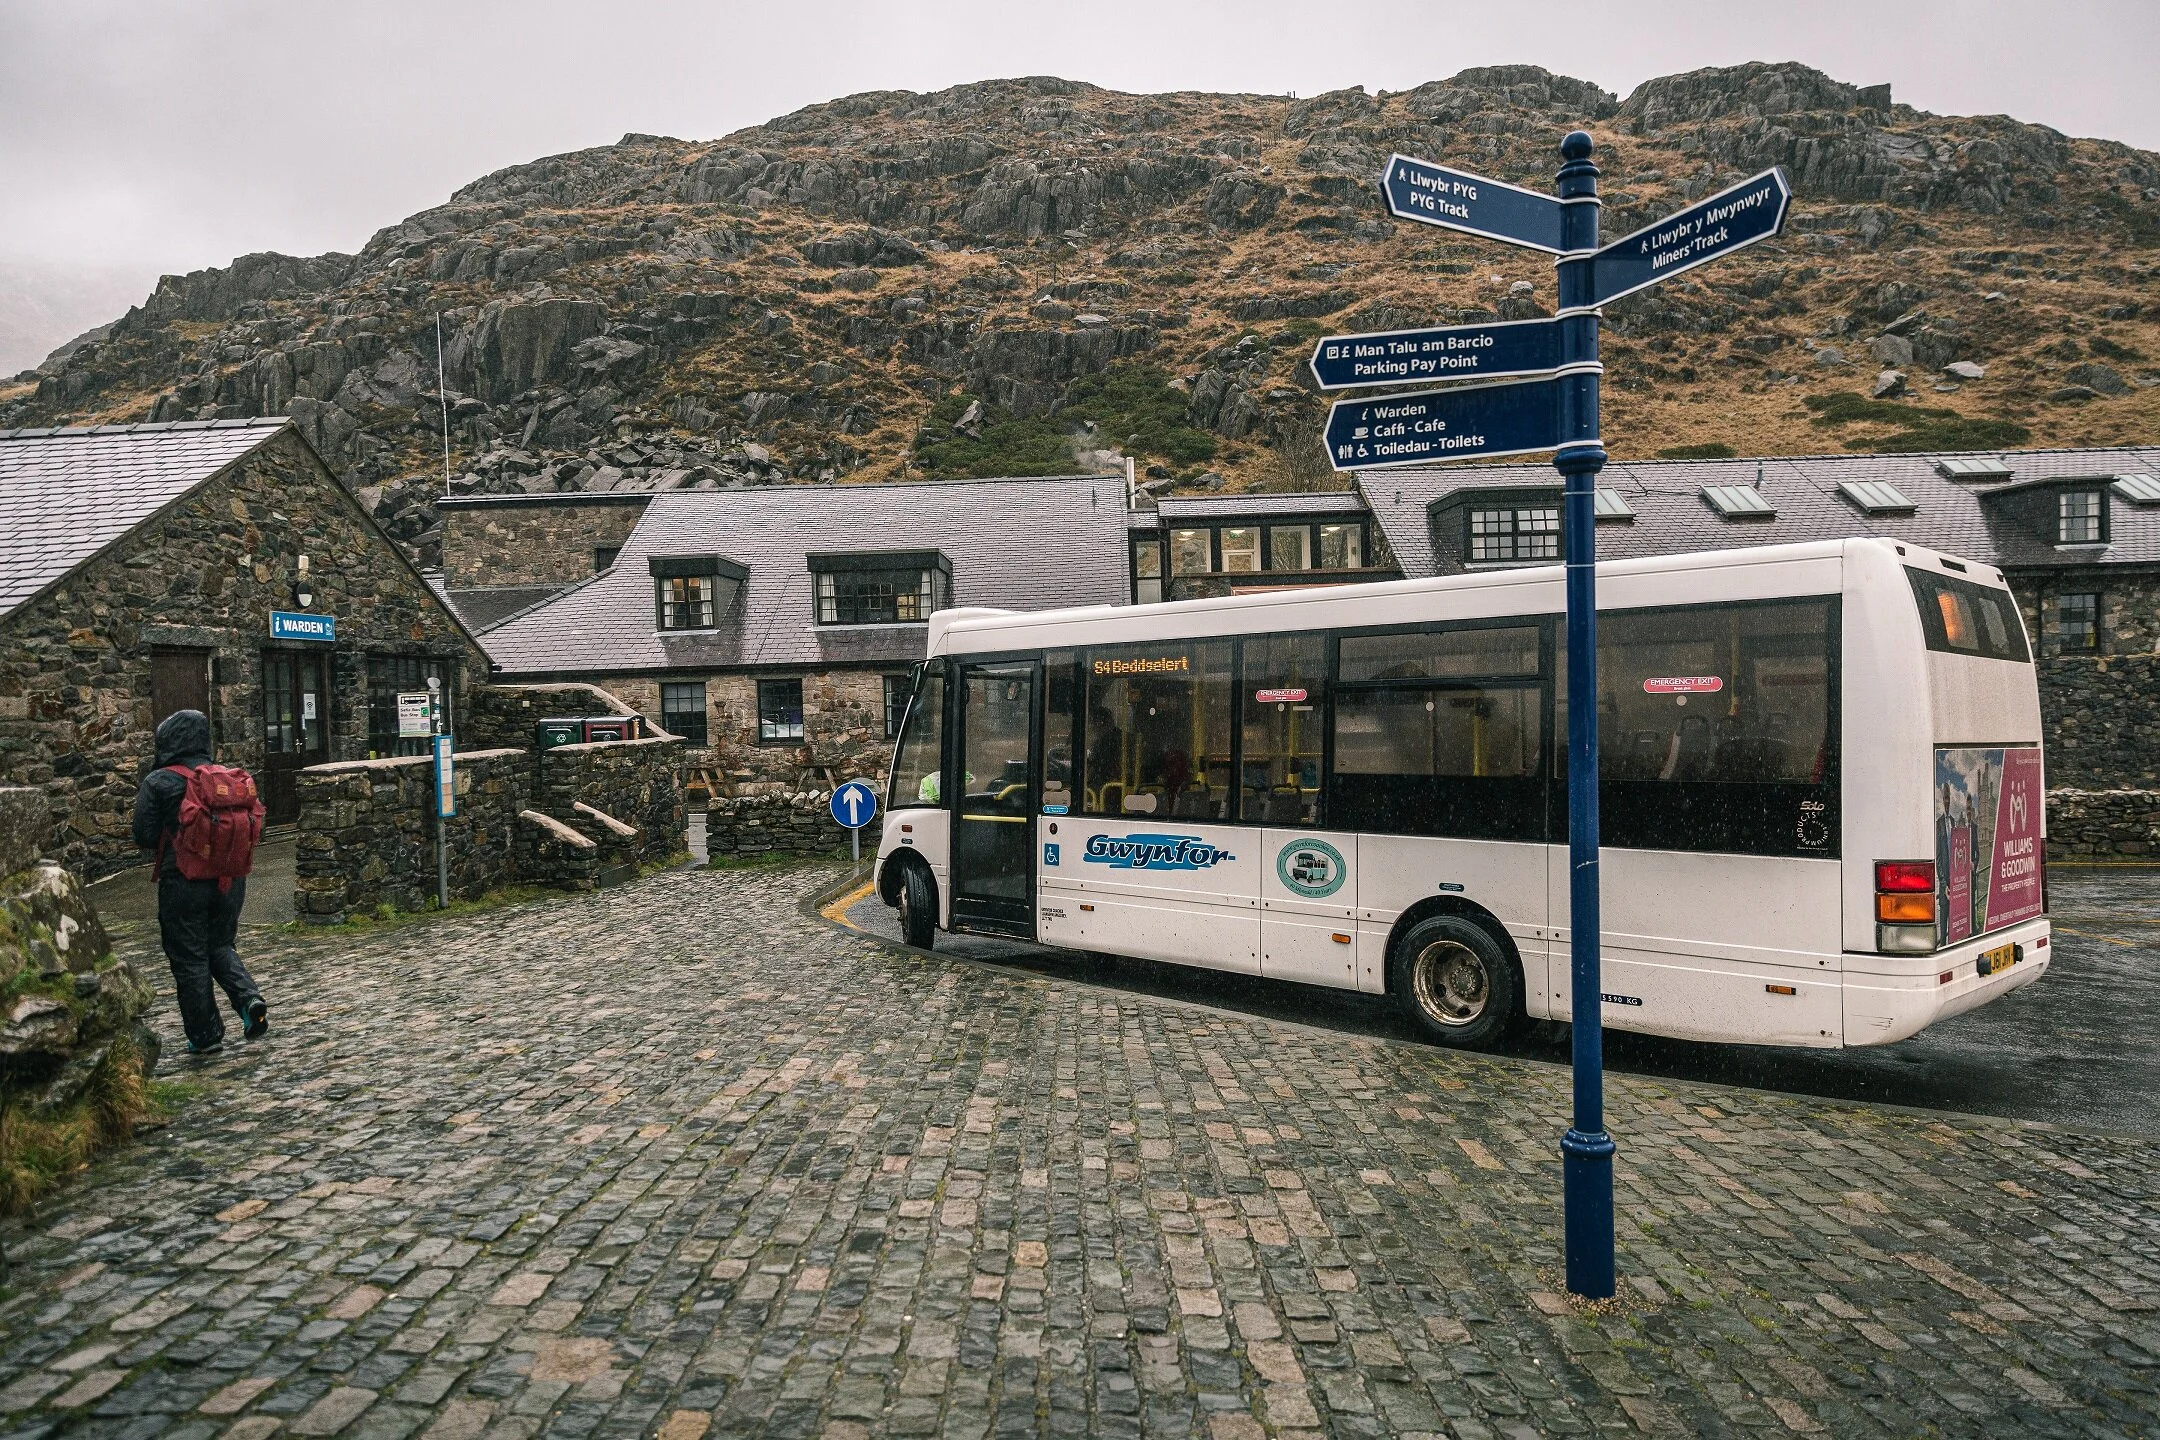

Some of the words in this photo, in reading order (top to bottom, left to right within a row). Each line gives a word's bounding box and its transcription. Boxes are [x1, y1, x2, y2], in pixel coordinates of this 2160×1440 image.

[1410, 170, 1450, 193] Llwybr
[1453, 181, 1477, 200] PYG
[1410, 191, 1435, 210] PYG
[1437, 198, 1469, 219] Track
[1652, 223, 1692, 249] Llwybr
[1695, 217, 1703, 234] y
[1706, 186, 1771, 226] Mwynwyr
[1694, 226, 1728, 251] Track
[1354, 344, 1384, 358] Man
[1387, 341, 1417, 355] Talu
[1421, 341, 1445, 352] am
[1447, 334, 1494, 350] Barcio
[1354, 360, 1408, 376] Parking
[1411, 358, 1437, 373] Pay
[1440, 354, 1478, 369] Point
[1374, 404, 1426, 419] Warden
[1414, 418, 1446, 433] Cafe
[1438, 434, 1485, 450] Toilets
[282, 619, 324, 634] WARDEN
[1094, 660, 1111, 674] S4
[1650, 678, 1696, 686] EMERGENCY
[1697, 677, 1715, 685] EXIT
[1800, 800, 1825, 811] Solo
[1086, 834, 1229, 868] Gwynfor
[2003, 836, 2033, 858] WILLIAMS
[2007, 855, 2036, 878] GOODWIN
[1626, 997, 1638, 1005] KG
